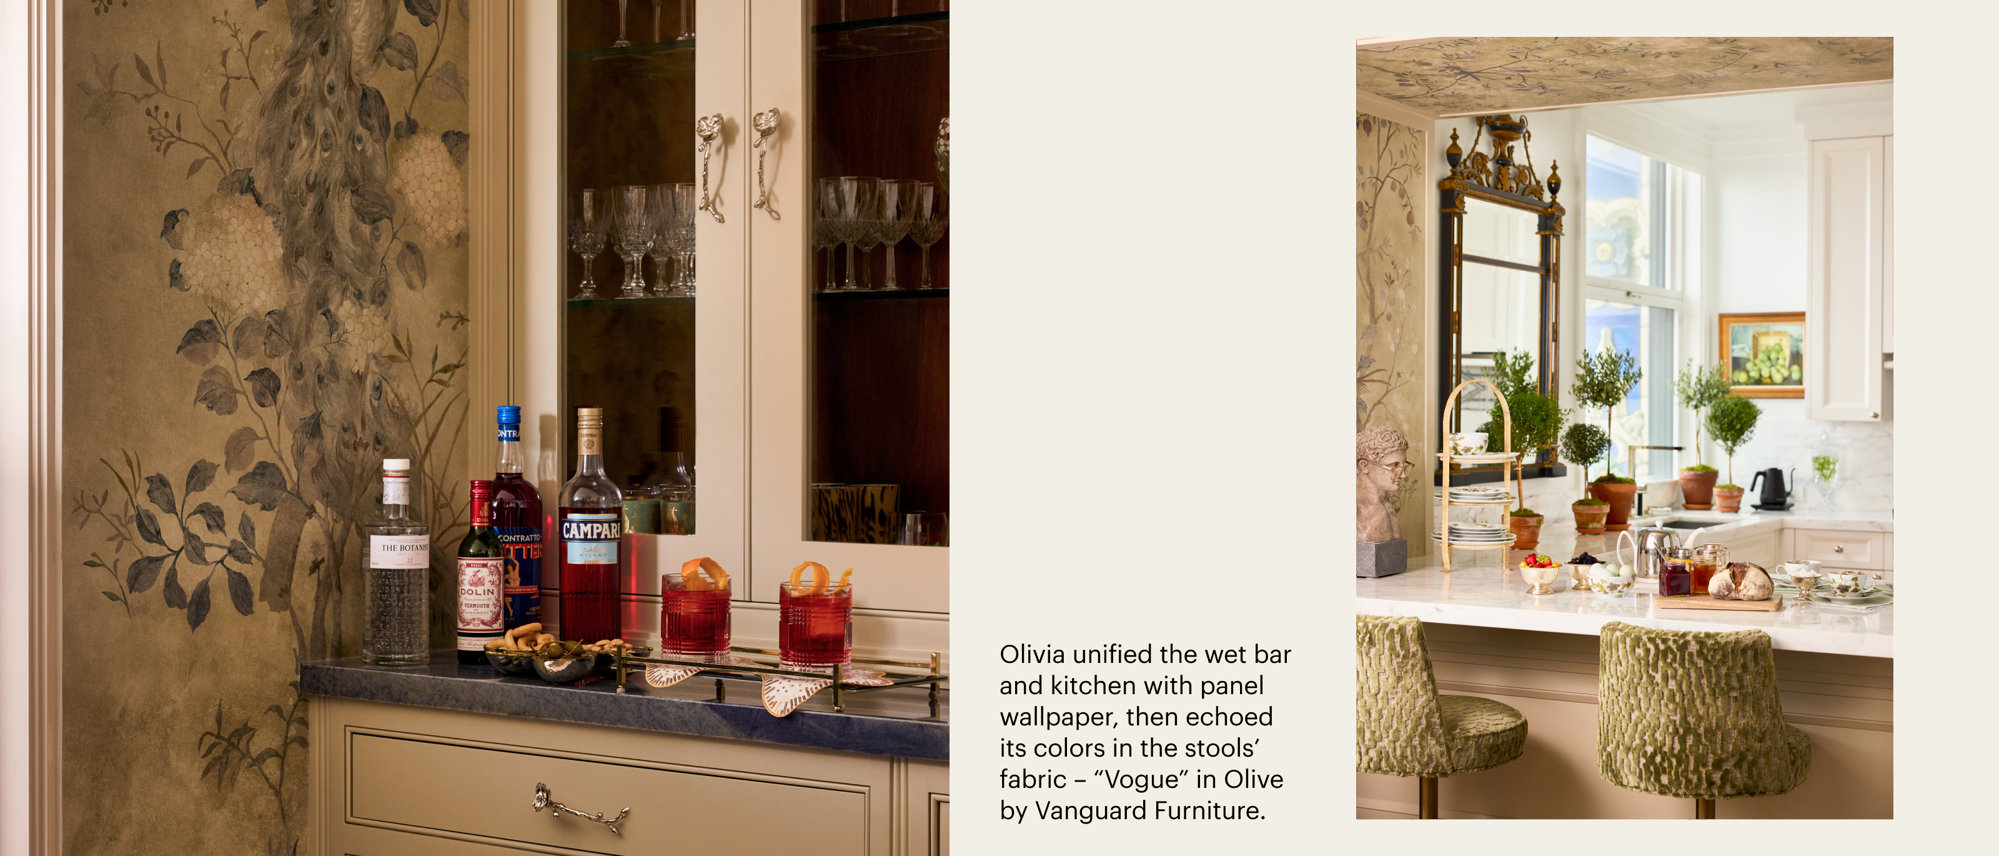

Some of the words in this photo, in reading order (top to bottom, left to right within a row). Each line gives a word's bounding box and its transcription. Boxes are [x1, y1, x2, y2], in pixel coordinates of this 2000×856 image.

[563, 522, 621, 539] CAMPARI
[498, 534, 541, 542] CONTRATTO
[382, 544, 398, 552] THE
[460, 588, 495, 596] DOLIN
